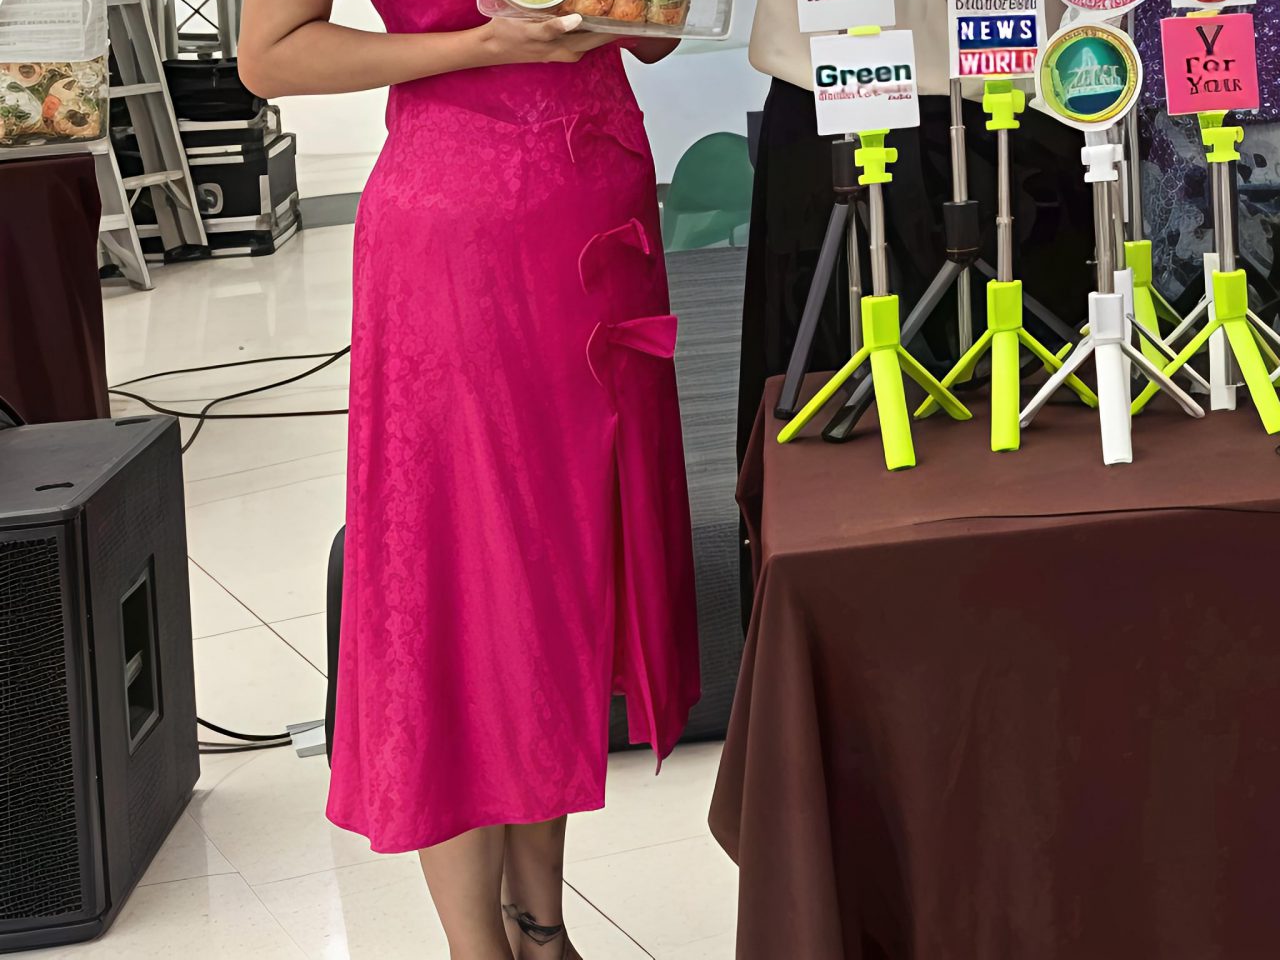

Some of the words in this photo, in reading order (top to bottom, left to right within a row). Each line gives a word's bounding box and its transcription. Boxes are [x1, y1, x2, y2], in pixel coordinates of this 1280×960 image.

[959, 18, 1034, 42] NEWS
[815, 63, 913, 88] Green
[959, 50, 1037, 76] WORLD
